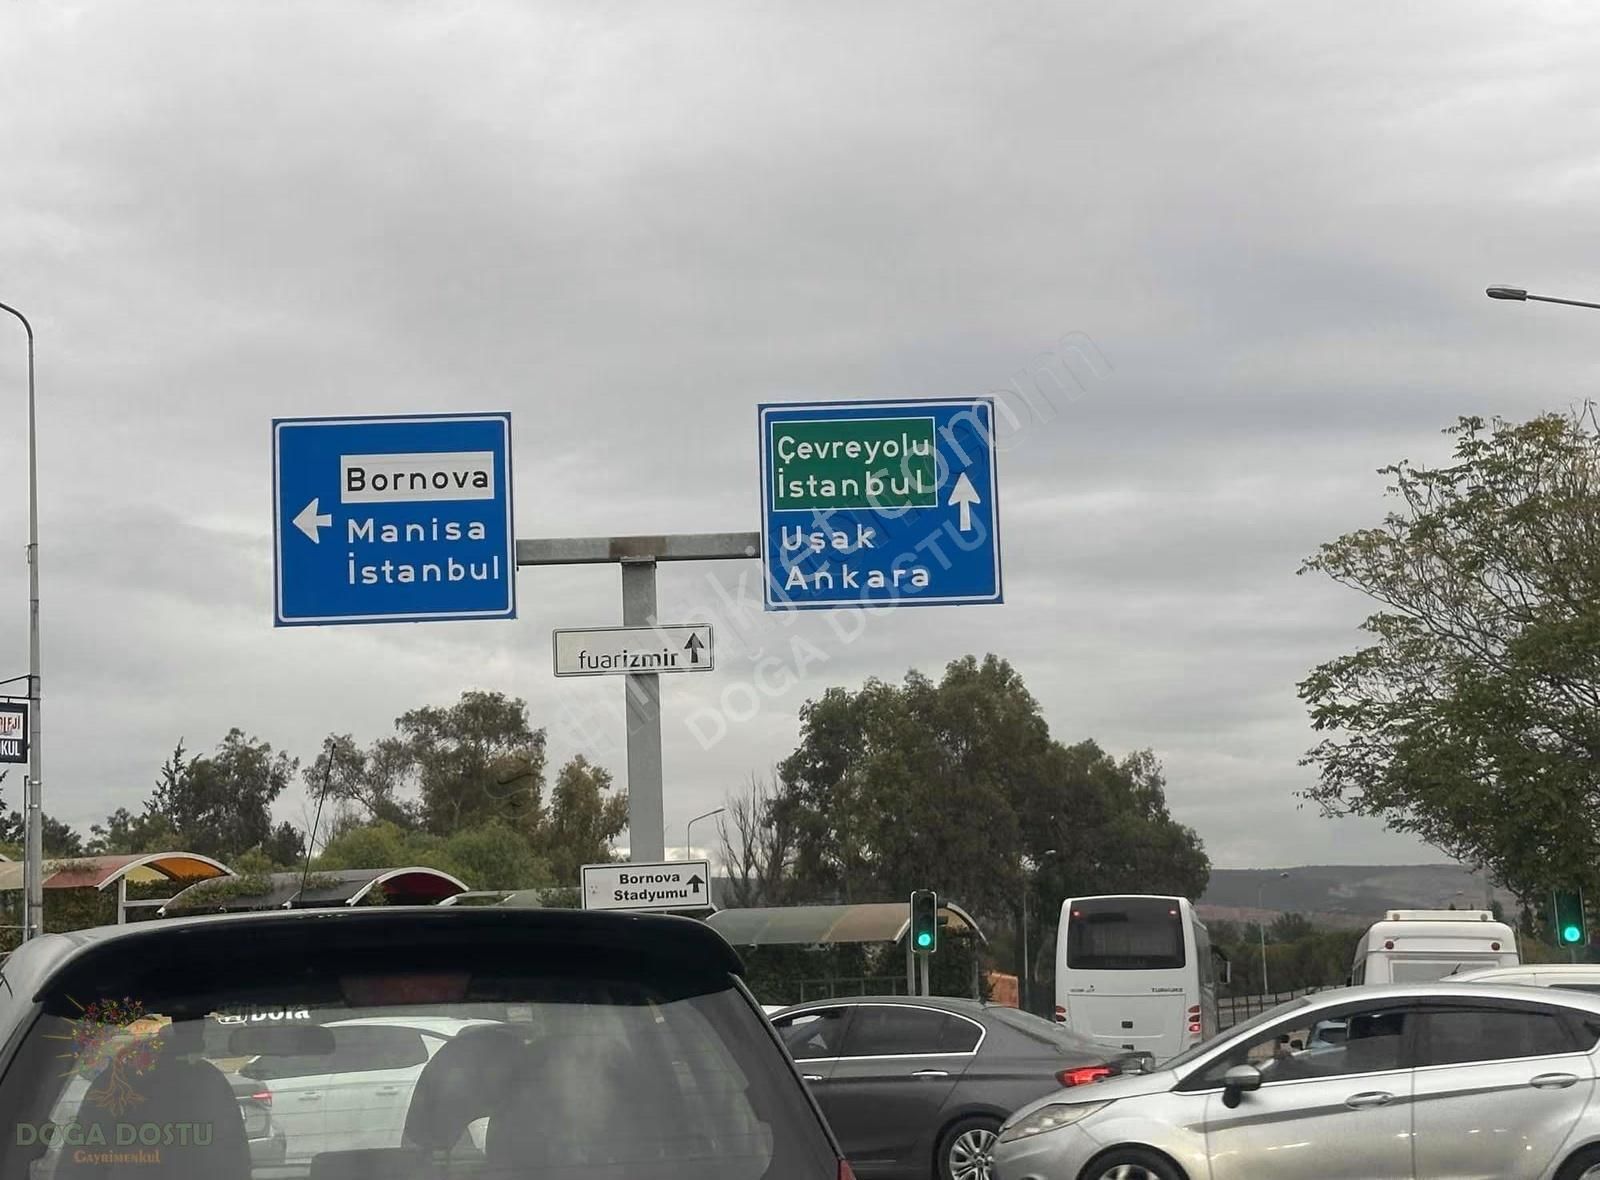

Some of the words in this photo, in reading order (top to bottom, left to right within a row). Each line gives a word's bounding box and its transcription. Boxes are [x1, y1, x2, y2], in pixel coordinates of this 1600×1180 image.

[777, 433, 931, 464] Çevreyolu
[346, 465, 489, 492] Bornova
[778, 468, 923, 498] İstanbul
[347, 517, 486, 544] Manisa
[780, 524, 876, 554] Uşak
[347, 553, 500, 585] İstanbul
[784, 564, 930, 591] Ankara
[578, 648, 679, 669] fuarizmir
[619, 873, 681, 884] Bornova
[614, 889, 688, 902] Stadyumu
